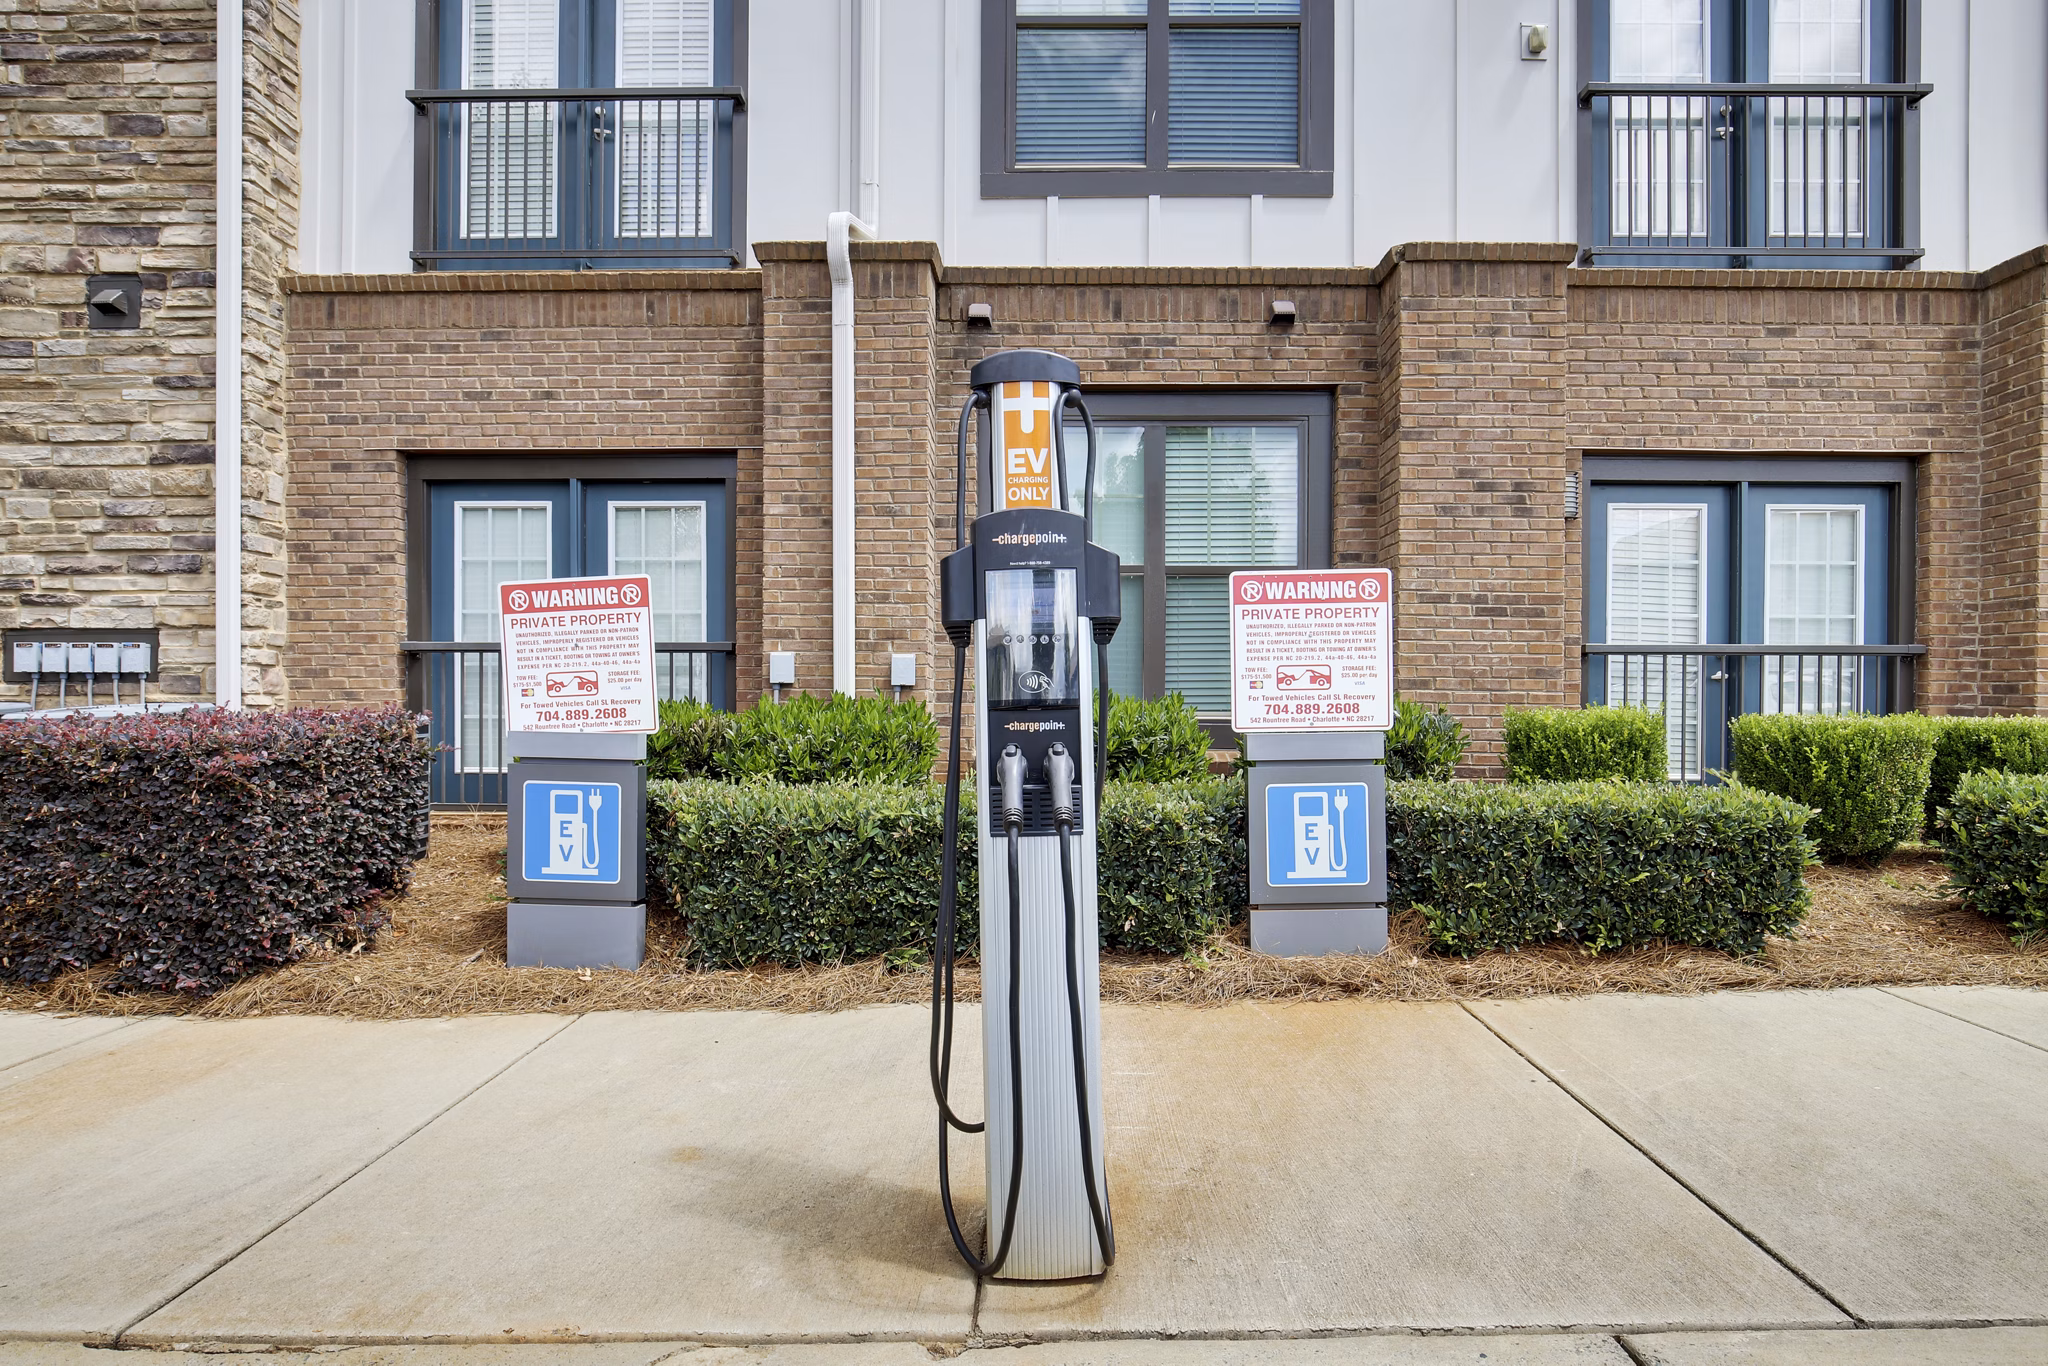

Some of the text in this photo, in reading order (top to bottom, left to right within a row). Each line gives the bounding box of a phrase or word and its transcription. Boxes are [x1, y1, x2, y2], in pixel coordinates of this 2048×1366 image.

[1008, 448, 1048, 474] EV
[1008, 476, 1048, 484] CHARGING
[1008, 486, 1050, 501] ONLY
[531, 586, 618, 608] WARNING
[1265, 580, 1356, 600] WARNING
[511, 612, 641, 629] PRIVATE PROPERTY
[1242, 607, 1380, 620] PRIVATE PROPERTY
[536, 708, 627, 722] 704.889.2608
[1264, 703, 1360, 714] 704.889.2608
[559, 820, 574, 862] EV
[1304, 823, 1320, 865] EV
